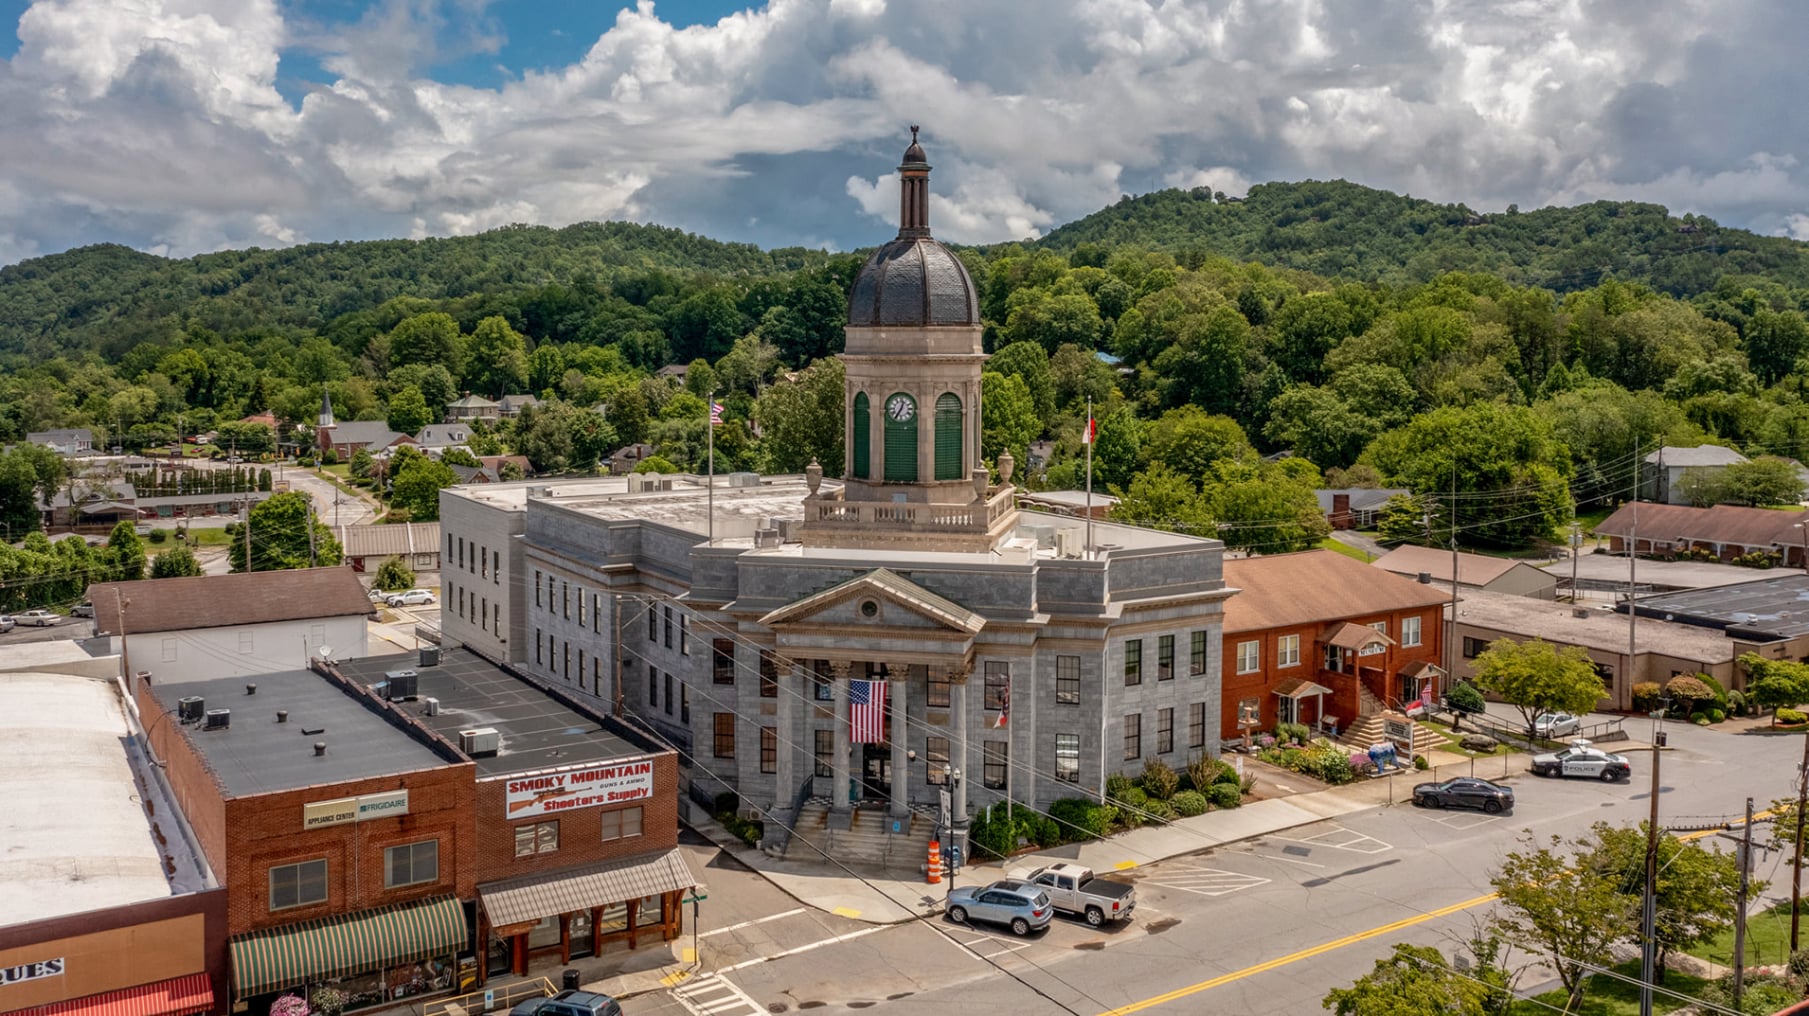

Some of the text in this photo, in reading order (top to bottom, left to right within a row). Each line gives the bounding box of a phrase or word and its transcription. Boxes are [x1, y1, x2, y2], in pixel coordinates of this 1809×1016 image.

[509, 763, 651, 793] SMOKY MOUNTAIN
[599, 781, 618, 789] GUNS
[626, 777, 645, 785] AMMO
[607, 787, 649, 801] Supply
[367, 799, 406, 811] FRIGIDAIRE
[308, 812, 355, 825] APPLIANCE CENTER
[0, 958, 62, 984] UES
